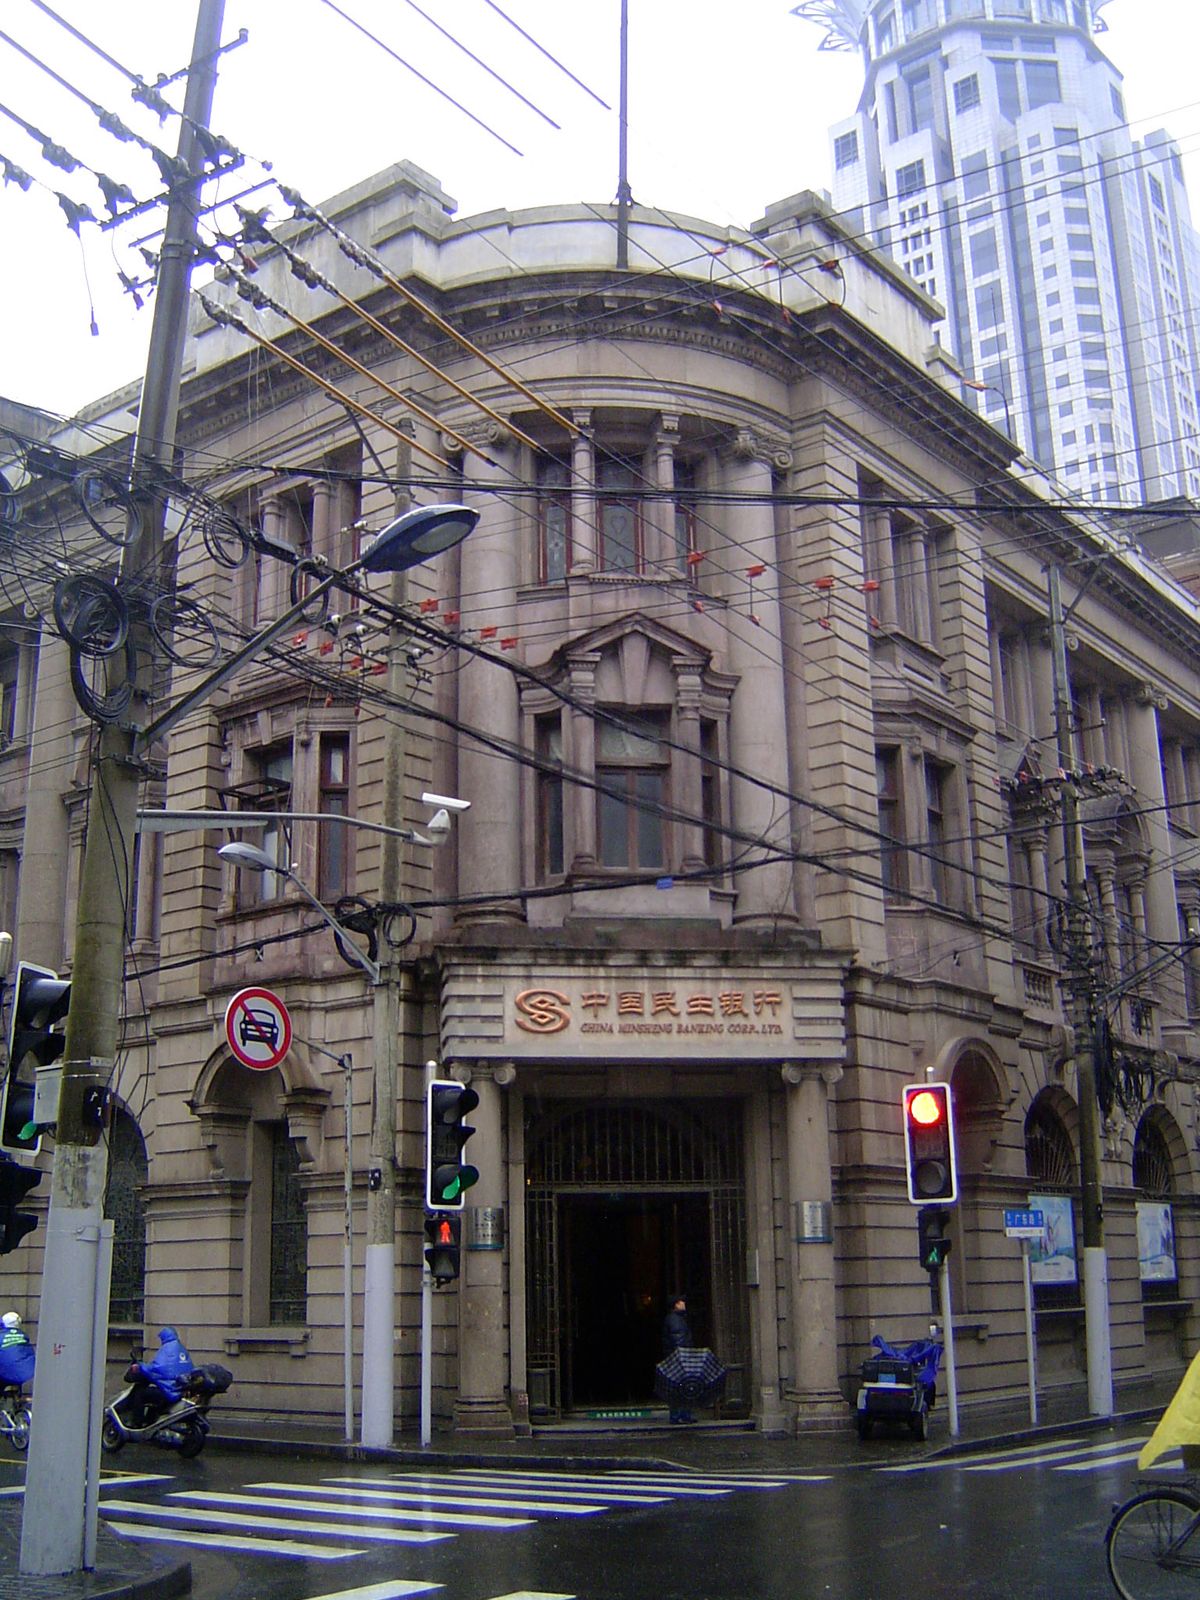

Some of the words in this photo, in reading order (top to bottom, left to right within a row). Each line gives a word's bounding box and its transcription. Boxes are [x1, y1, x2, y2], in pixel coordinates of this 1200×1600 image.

[581, 991, 783, 1018] 中国民生银行
[580, 1023, 614, 1034] CHINA
[618, 1023, 672, 1034] MINSHENG
[676, 1023, 724, 1034] BANKING
